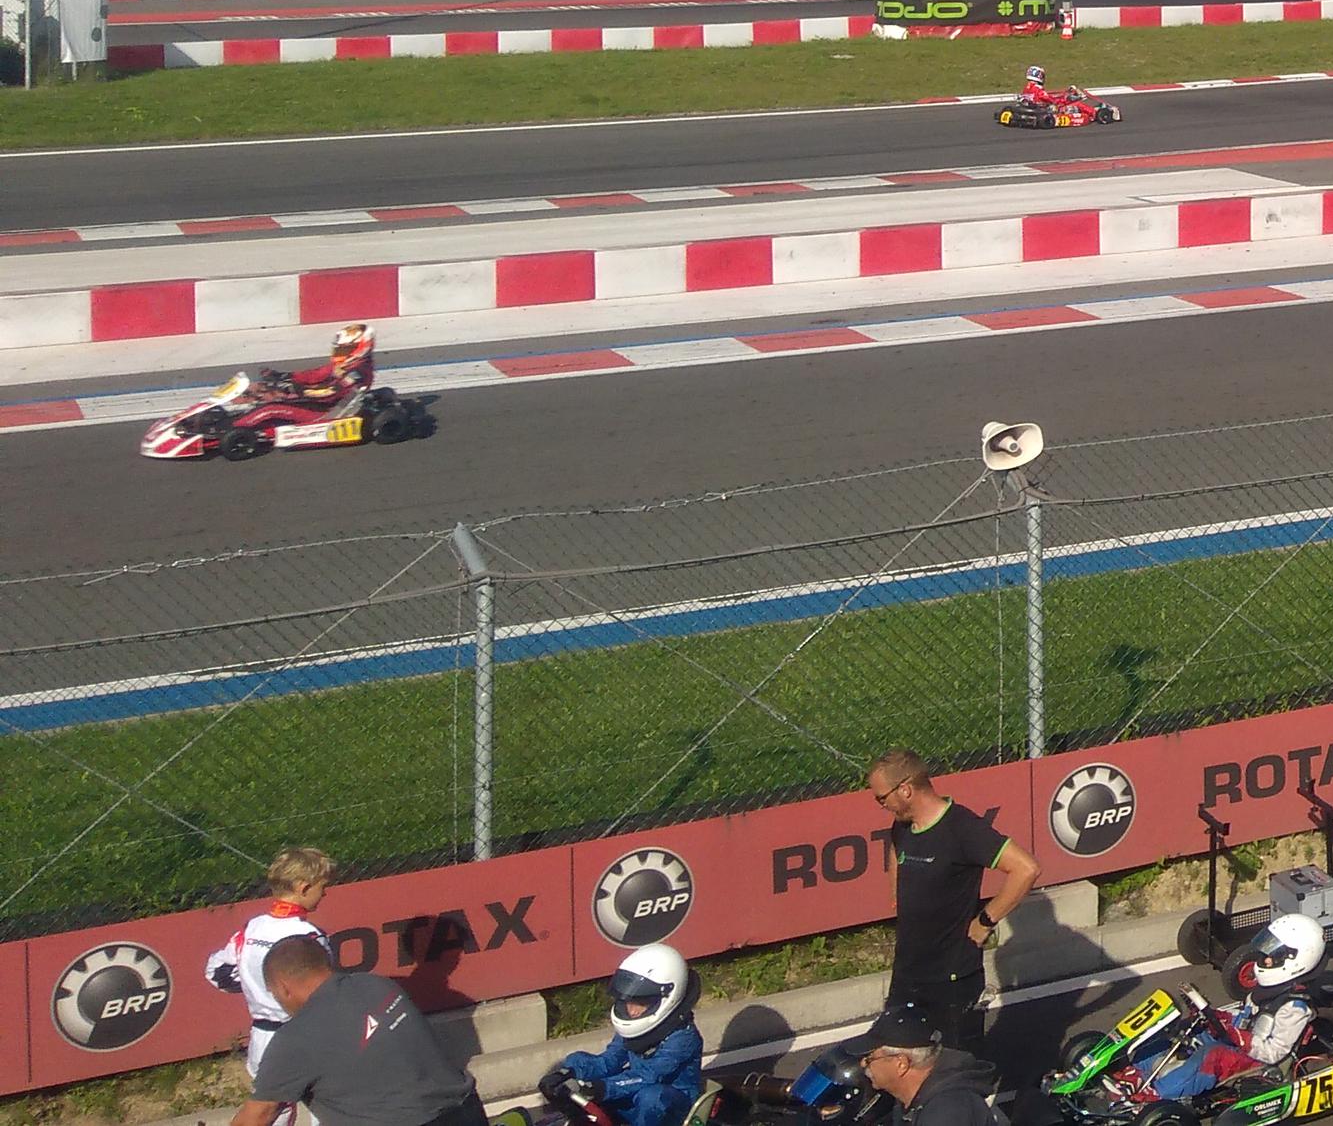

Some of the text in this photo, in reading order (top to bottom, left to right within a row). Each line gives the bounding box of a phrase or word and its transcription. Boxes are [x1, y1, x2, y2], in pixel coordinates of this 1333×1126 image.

[1085, 805, 1132, 831] BRP
[633, 891, 690, 919] BRP
[328, 895, 538, 974] OTAX
[100, 990, 167, 1019] BRP
[1124, 999, 1162, 1031] 75
[1303, 1075, 1333, 1113] 75
